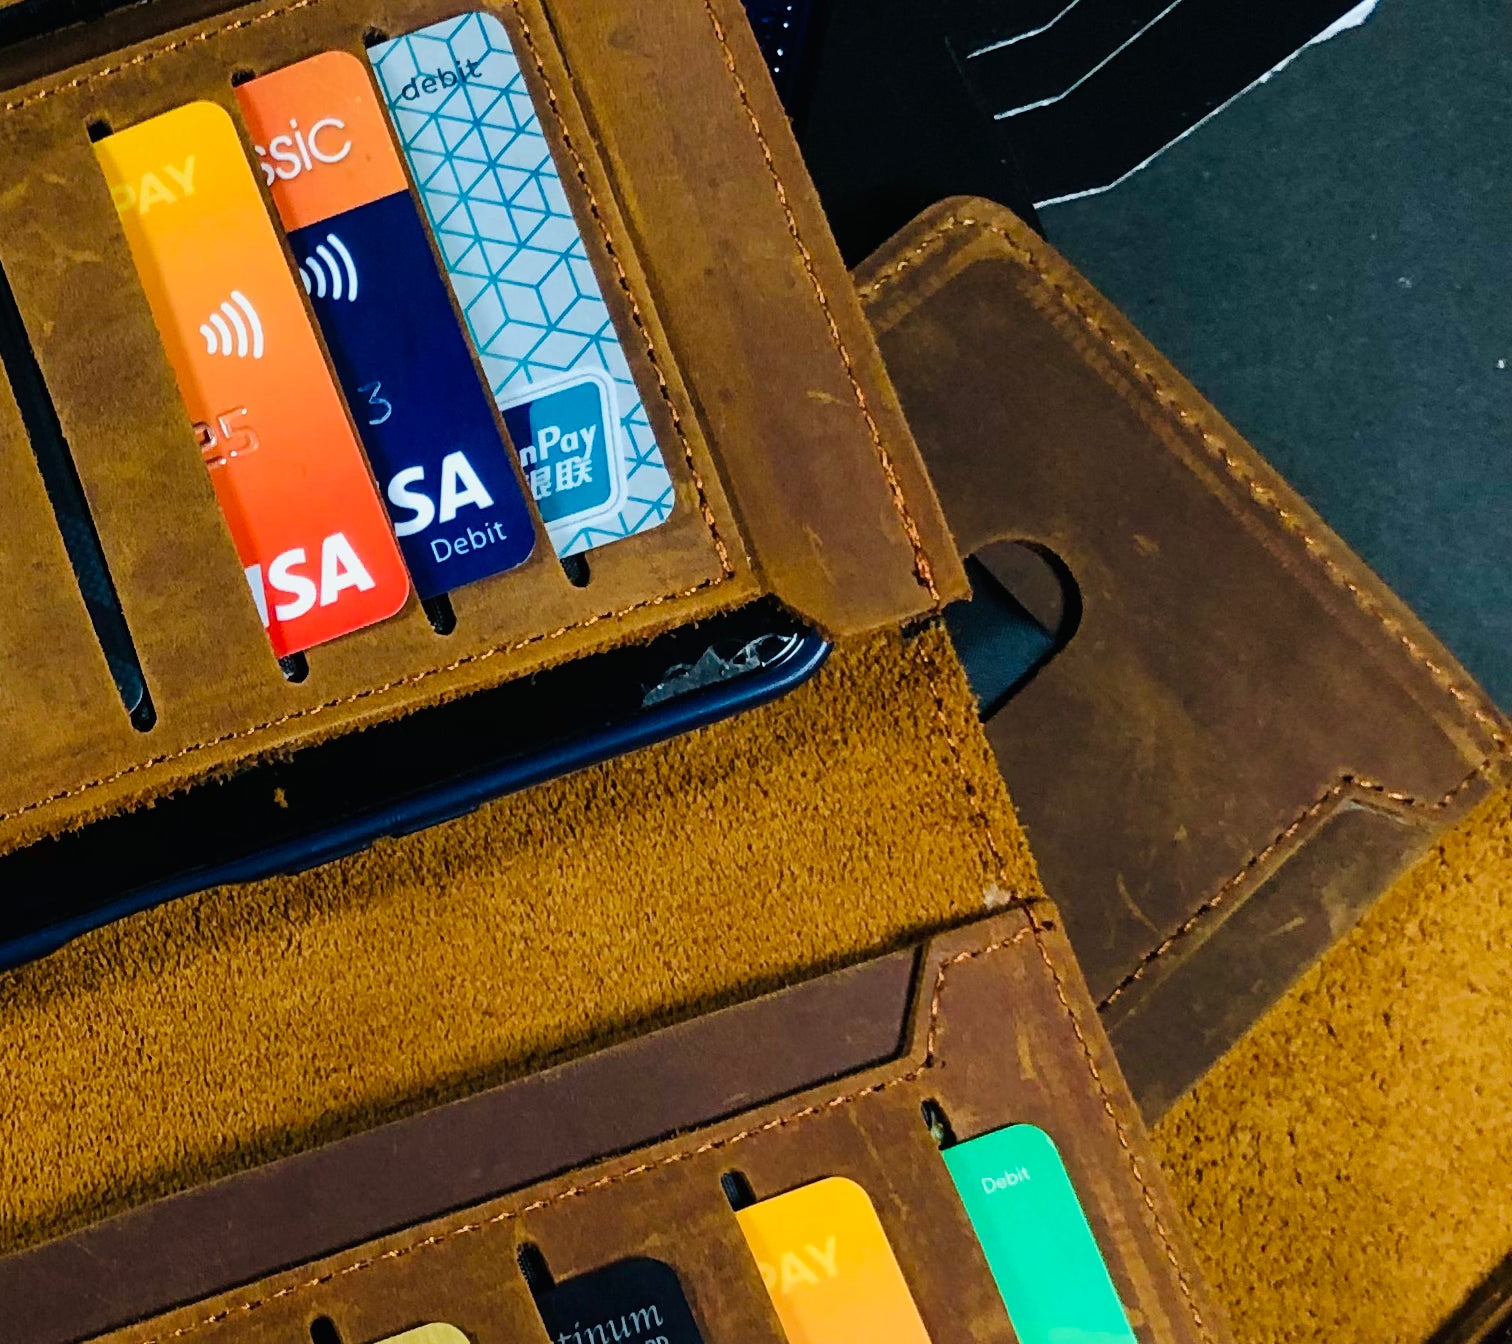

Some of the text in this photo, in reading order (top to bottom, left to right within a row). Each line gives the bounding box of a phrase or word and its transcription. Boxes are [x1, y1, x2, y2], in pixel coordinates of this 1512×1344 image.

[402, 59, 482, 100] debit
[358, 381, 392, 426] 3
[430, 521, 507, 563] Debit
[981, 1166, 1031, 1194] Debit
